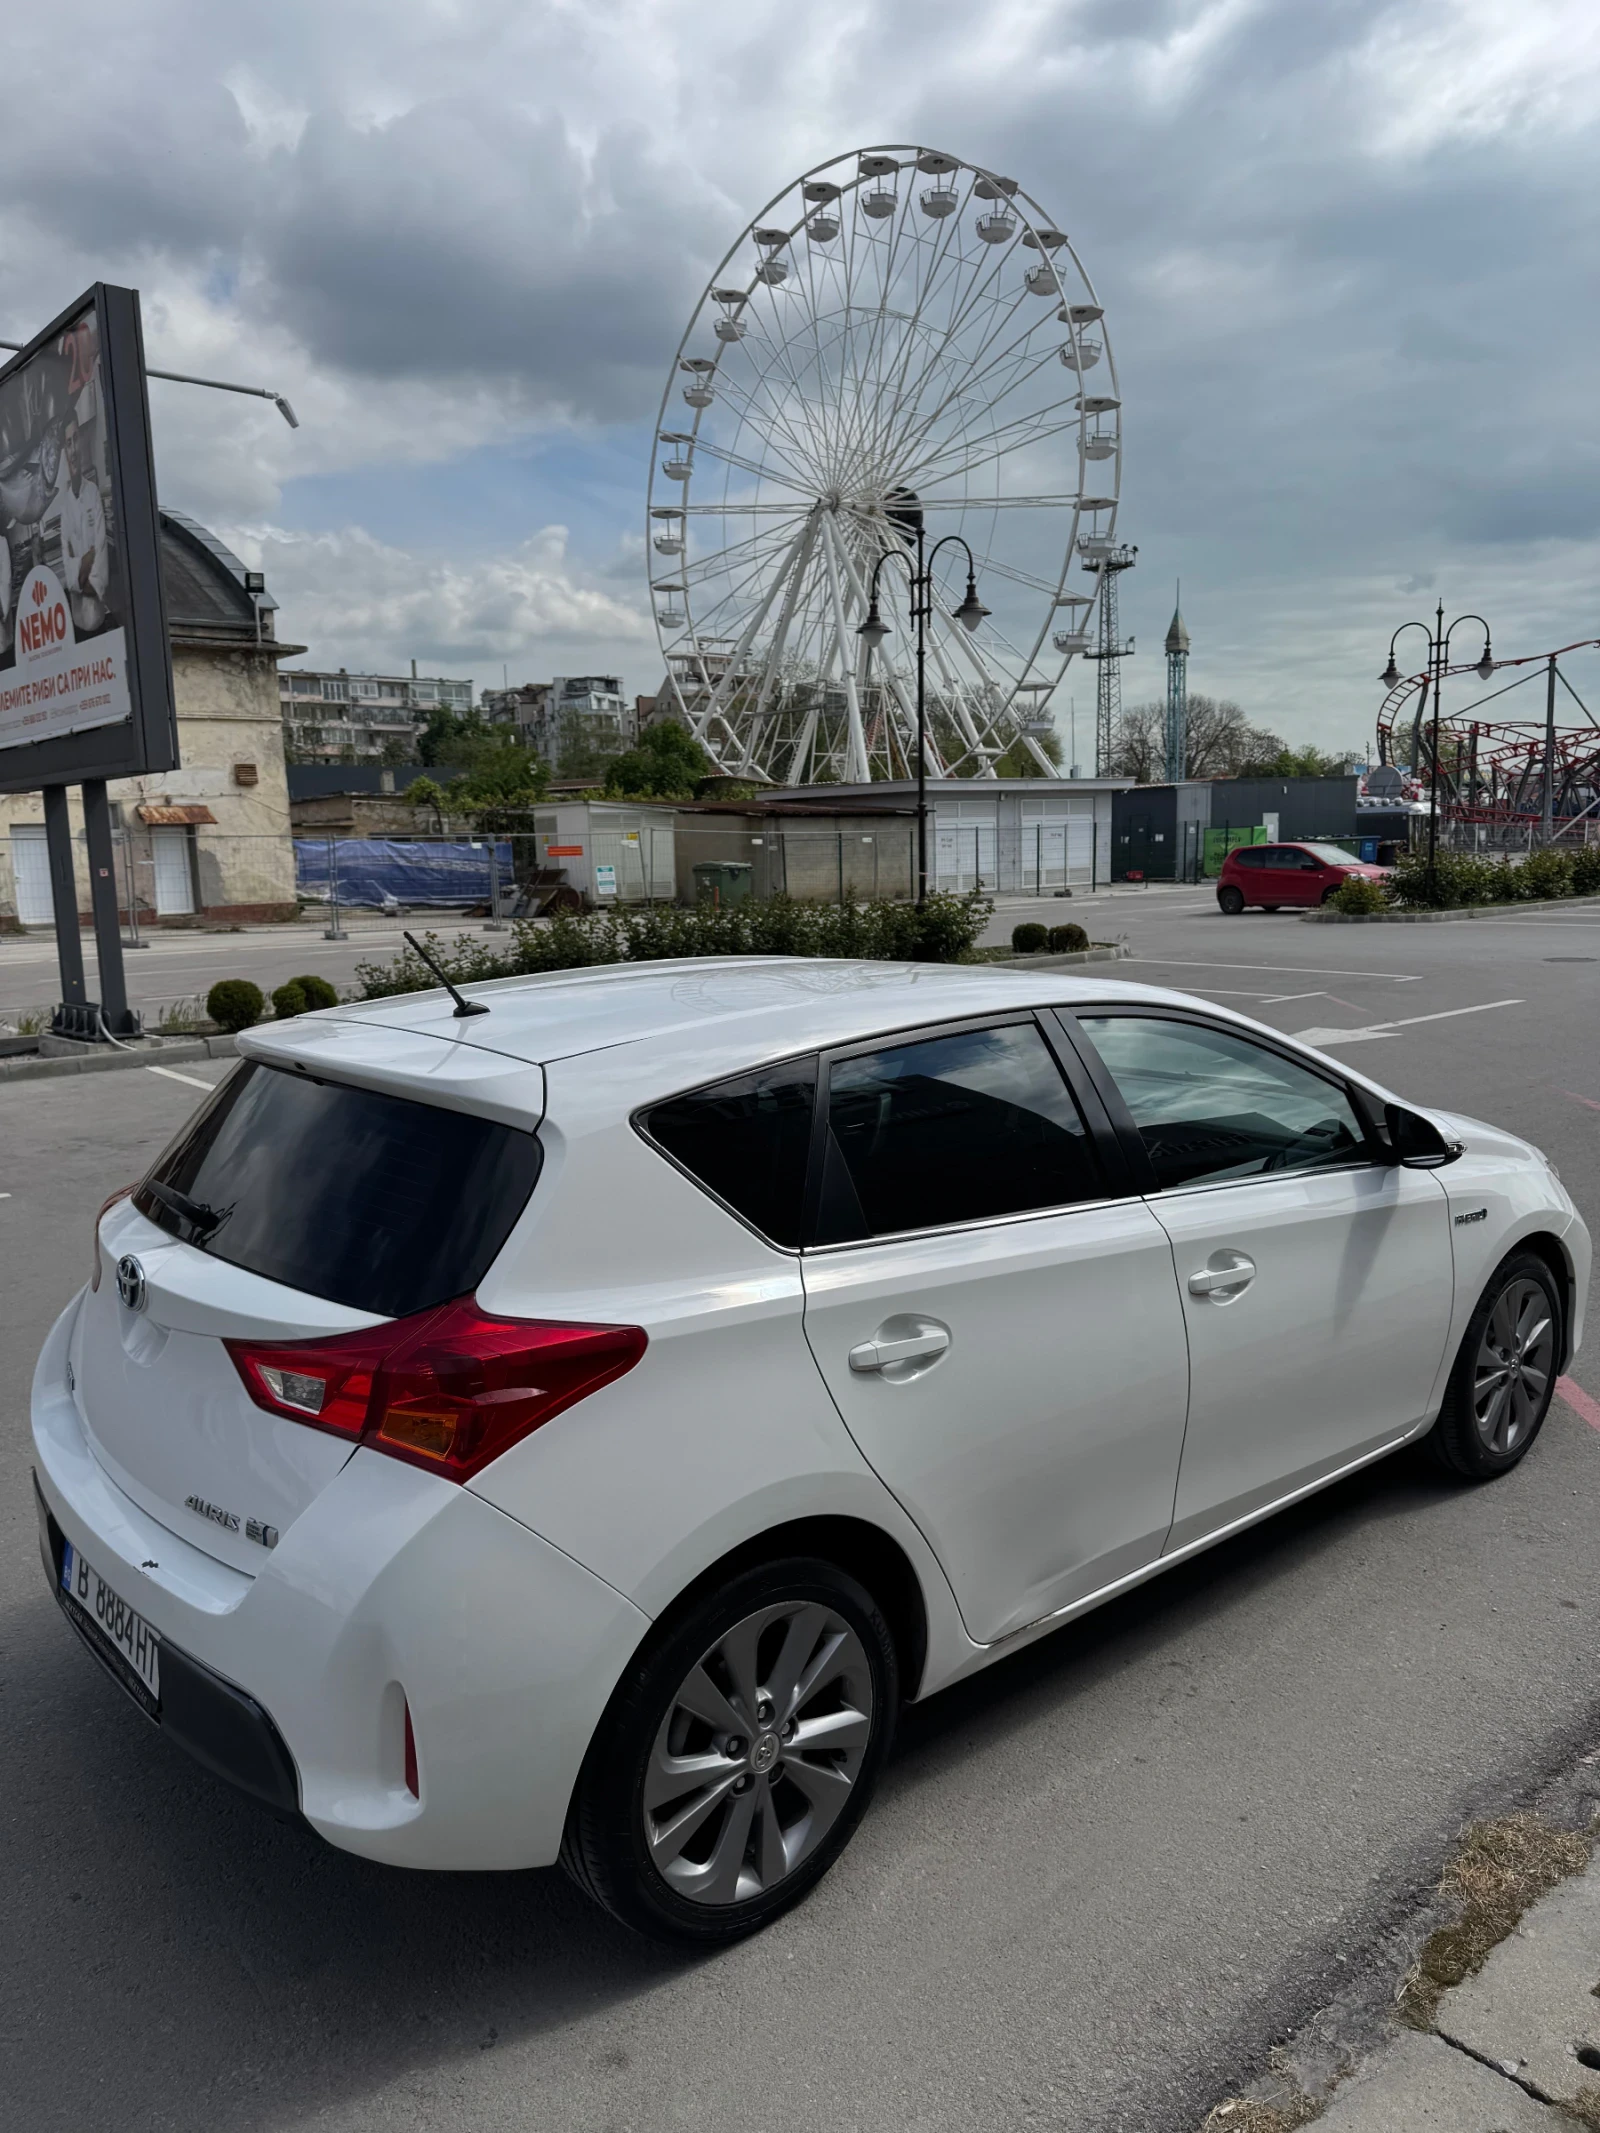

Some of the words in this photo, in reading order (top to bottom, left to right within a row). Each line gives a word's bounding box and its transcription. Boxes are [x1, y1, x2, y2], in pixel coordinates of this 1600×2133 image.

[19, 602, 67, 654] NEMO
[32, 676, 56, 703] РИБИ
[56, 672, 70, 695] СА
[70, 664, 91, 692] ПРИ
[92, 657, 116, 684] НАС.
[184, 1493, 241, 1533] AURIS
[77, 1557, 89, 1600] B
